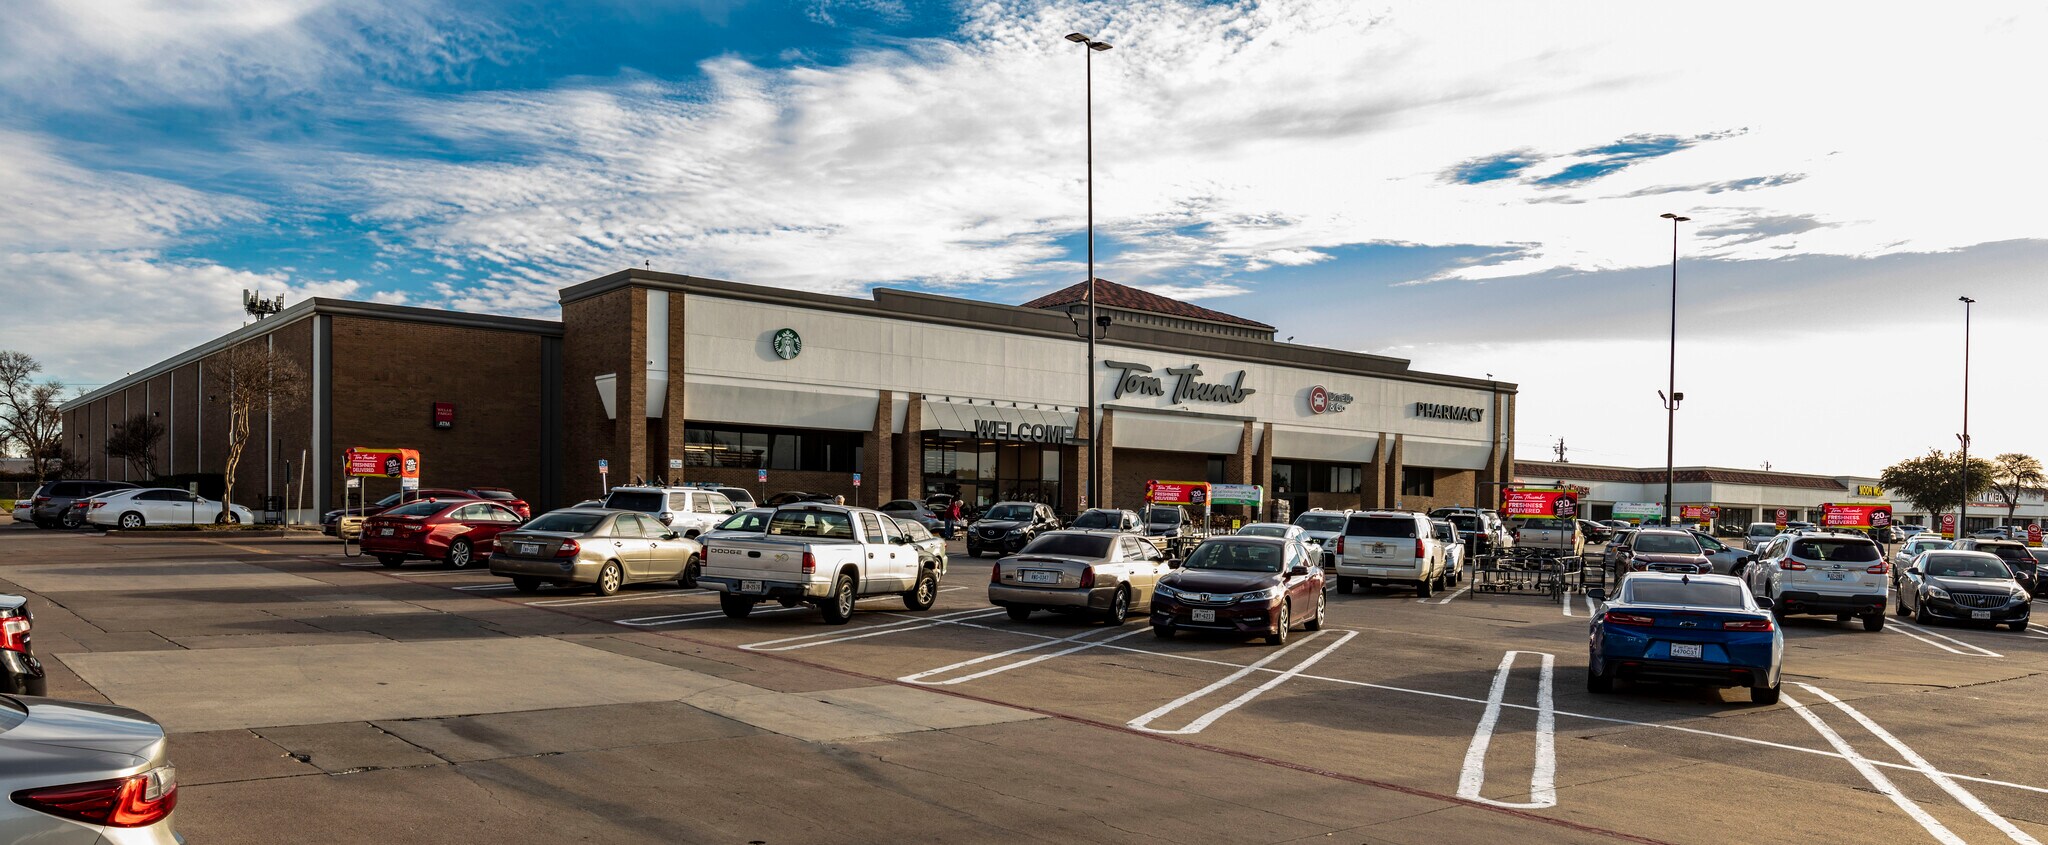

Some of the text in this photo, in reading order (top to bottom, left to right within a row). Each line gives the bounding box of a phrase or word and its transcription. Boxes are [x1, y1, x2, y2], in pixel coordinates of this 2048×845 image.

[1104, 360, 1256, 404] Tom Thumb
[1416, 402, 1484, 422] PHARMACY
[974, 419, 1074, 444] WELCOME
[1555, 499, 1570, 508] $20
